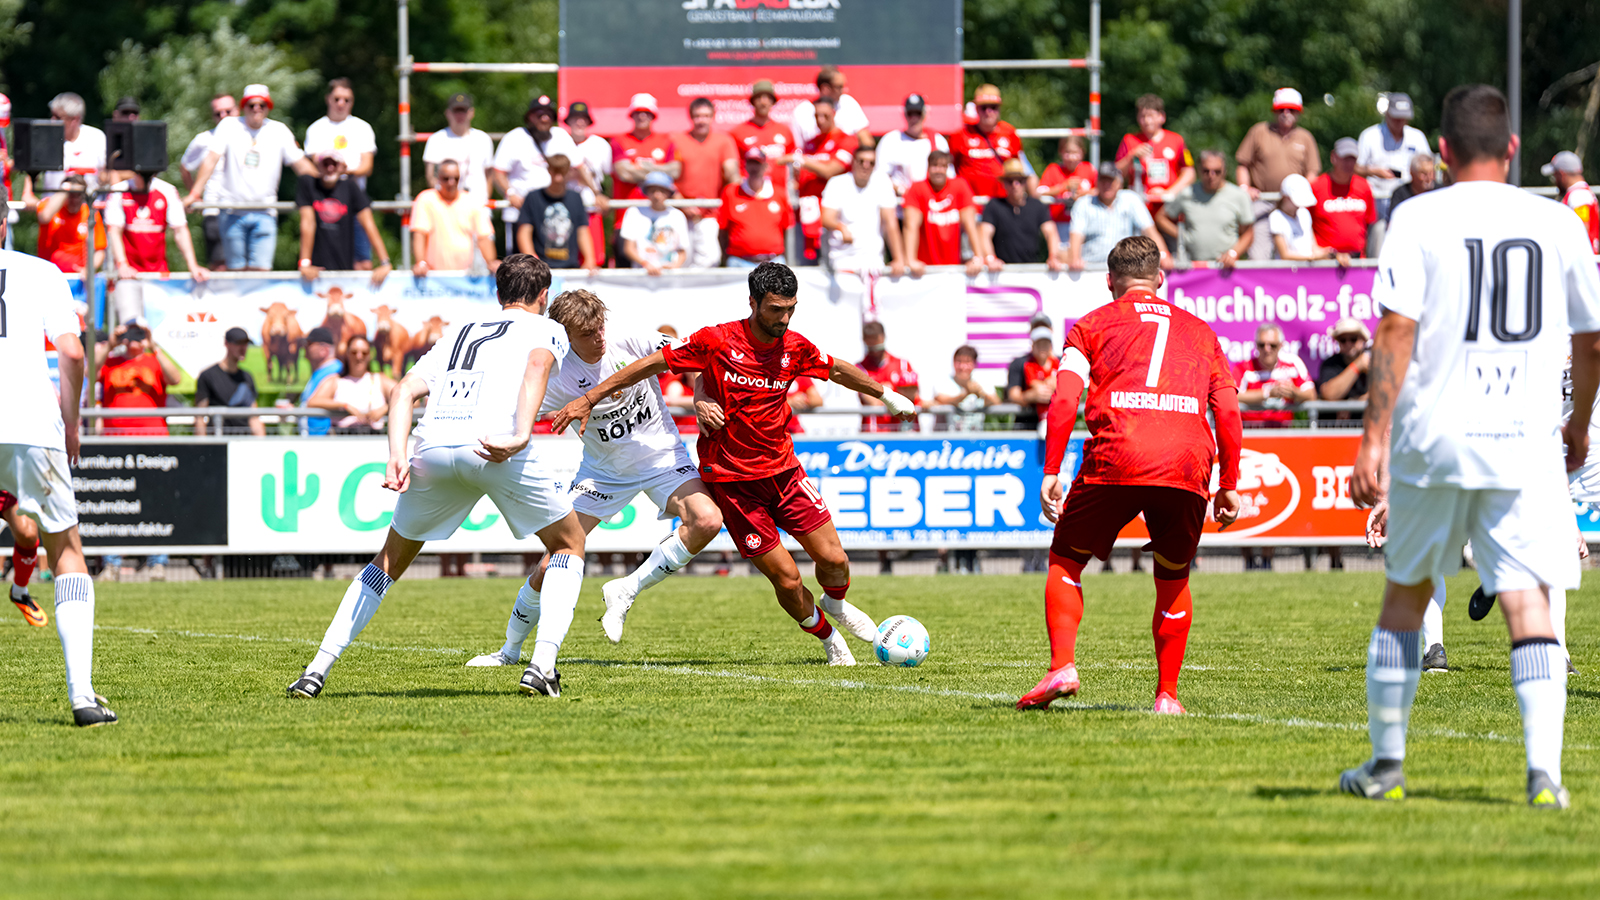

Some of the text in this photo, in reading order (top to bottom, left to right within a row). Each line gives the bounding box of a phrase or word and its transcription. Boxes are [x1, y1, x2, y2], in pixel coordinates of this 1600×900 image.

[1133, 302, 1172, 316] RITTER
[1464, 238, 1543, 343] 10
[447, 320, 514, 372] 17
[1140, 313, 1170, 387] 7
[1110, 391, 1199, 415] KAISERSLAUTERN
[597, 406, 652, 443] BÖHM
[77, 453, 124, 470] urniture
[136, 453, 179, 472] Design
[72, 476, 137, 492] Büromöbel
[811, 475, 1026, 528] EBER
